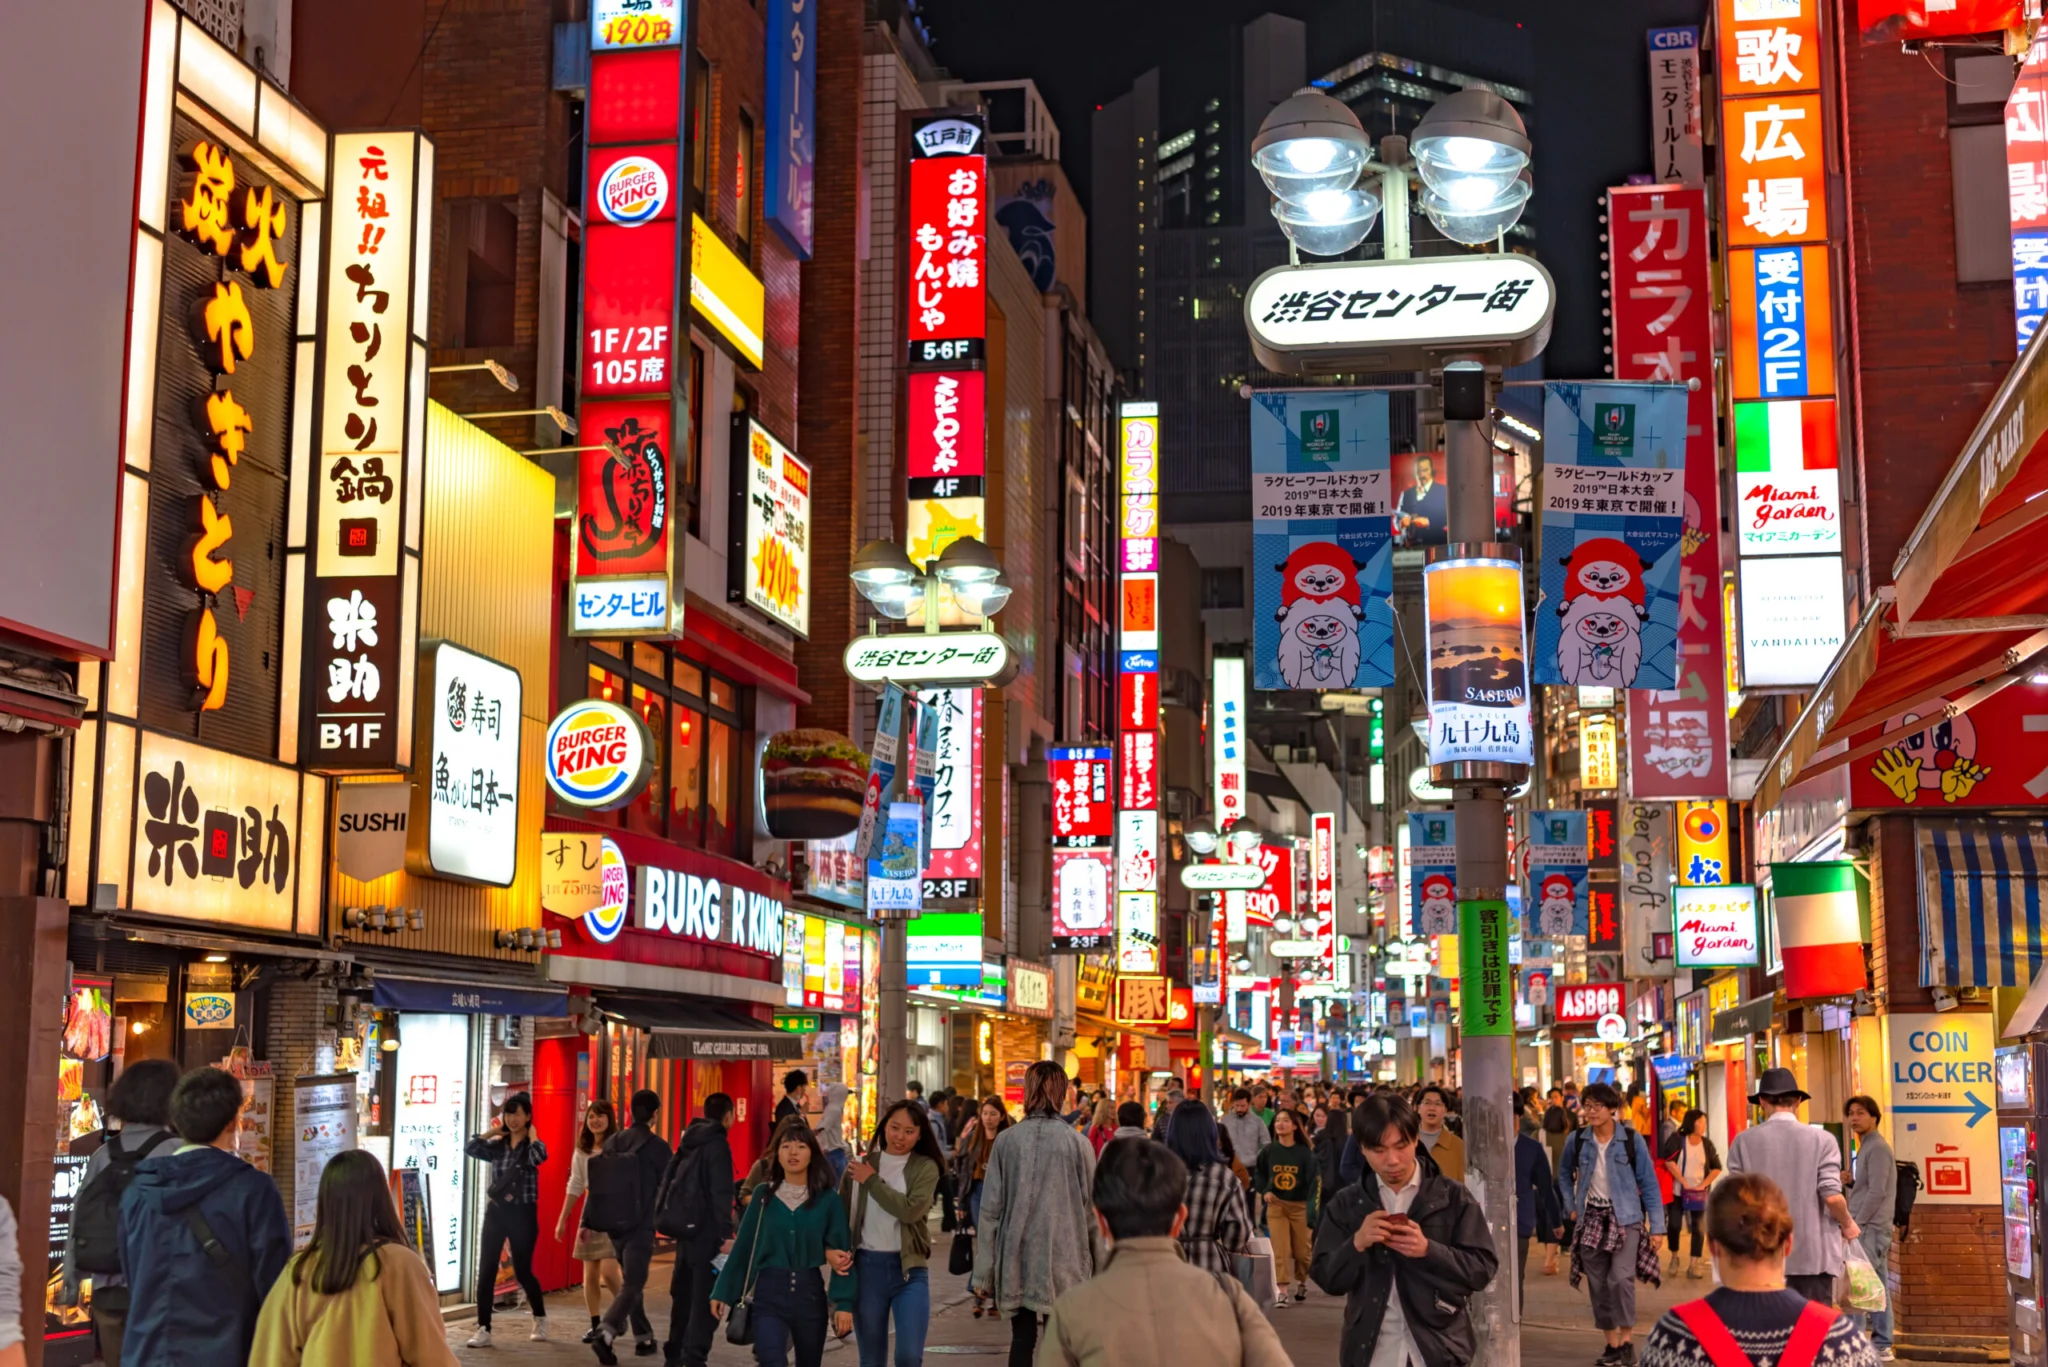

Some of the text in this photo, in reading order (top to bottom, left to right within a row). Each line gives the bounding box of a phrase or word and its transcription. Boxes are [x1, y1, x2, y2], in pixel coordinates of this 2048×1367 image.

[605, 18, 672, 45] 190円
[1654, 31, 1694, 48] CBR
[1660, 58, 1682, 179] モニタールーム
[1735, 26, 1809, 237] 歌広場
[923, 128, 974, 148] 江戸前
[609, 170, 656, 194] BURGER
[610, 183, 657, 212] KING
[946, 168, 978, 288] お好み焼
[915, 223, 945, 331] もんじゃ
[1629, 197, 1699, 385] カラオ
[1262, 278, 1535, 324] 渋谷センター街
[1757, 251, 1803, 393] 受付2F
[592, 356, 665, 385] 105席
[181, 140, 289, 711] 炭火やきとり
[646, 448, 665, 529] とうがらし料理
[933, 478, 960, 497] 4F
[1126, 421, 1155, 536] カラオケ
[1264, 473, 1380, 487] ラグビーワールドカップ
[1554, 467, 1674, 483] ラグビーワールドカップ
[1744, 484, 1820, 502] Miami
[1753, 504, 1835, 529] garden
[1338, 532, 1390, 540] 大会公式マスコット
[1626, 531, 1680, 539] 大会公式マスコット
[760, 532, 800, 606] 190円
[578, 592, 665, 618] センタービル
[327, 590, 381, 703] 米助
[1751, 637, 1839, 647] VANDALISM
[855, 646, 999, 668] 渋谷センター街
[1465, 686, 1522, 702] SASEBO
[471, 690, 502, 741] 寿司
[320, 722, 382, 749] B1F
[557, 725, 627, 753] BURGER
[1440, 720, 1520, 746] 九十九島
[557, 742, 628, 778] KING
[1136, 733, 1154, 808] ラーメン
[433, 751, 514, 816] 魚がし日本一
[1073, 761, 1090, 823] お好み焼
[1055, 778, 1072, 834] もんじゃ
[144, 760, 290, 894] 米助
[338, 813, 406, 833] SUSHI
[546, 839, 599, 871] すし
[1687, 855, 1722, 884] 松
[603, 867, 624, 883] RGER
[1628, 850, 1666, 910] craft
[603, 883, 625, 906] ING
[645, 866, 783, 956] BURGR KING
[1679, 919, 1738, 933] Miami
[907, 943, 963, 952] FamyMart
[1479, 909, 1502, 1026] 客引きは犯罪です
[1122, 979, 1166, 1020] 豚
[1562, 986, 1620, 1017] ASBee
[1908, 1031, 1969, 1053] COIN
[1894, 1062, 1993, 1084] LOCKER
